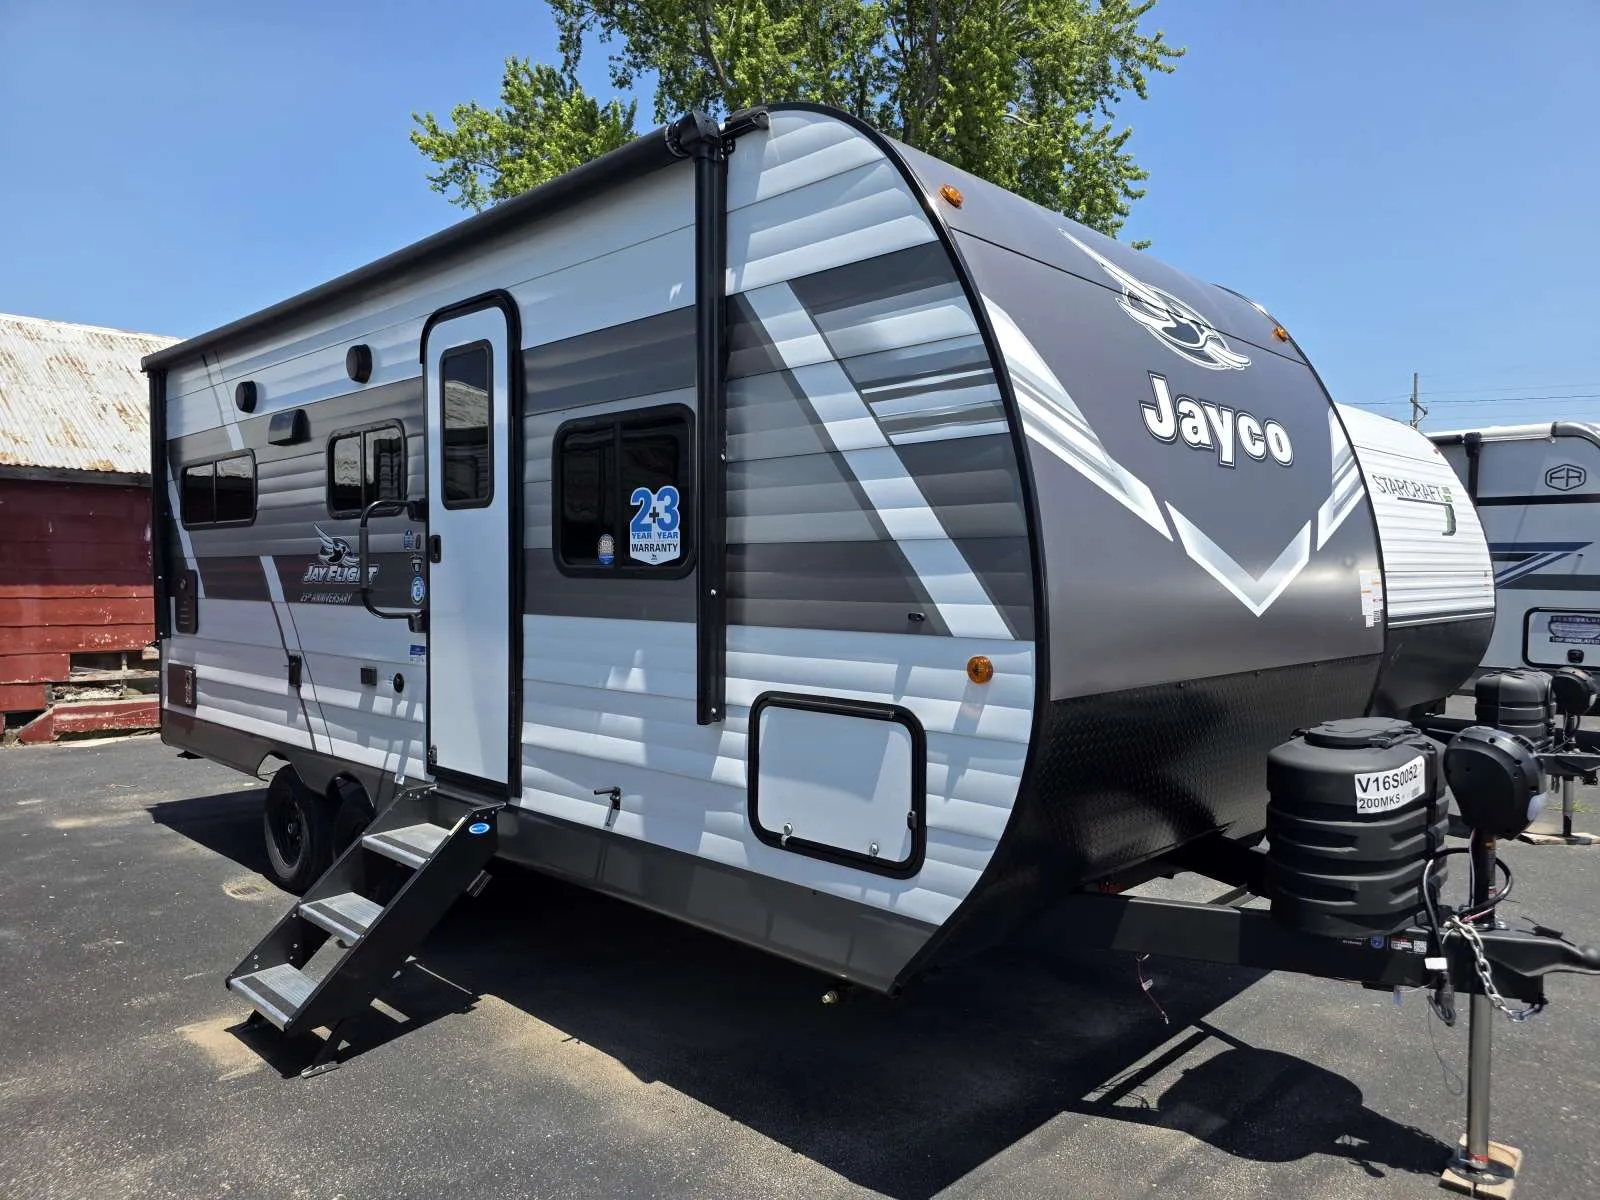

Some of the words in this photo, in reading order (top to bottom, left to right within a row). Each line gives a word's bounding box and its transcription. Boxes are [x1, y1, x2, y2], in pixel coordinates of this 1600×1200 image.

[1139, 371, 1294, 468] Jayco
[1372, 475, 1444, 502] STARCRAFT
[631, 543, 678, 552] WARRANTY
[303, 564, 328, 584] JAY
[1357, 764, 1418, 793] V16S0052
